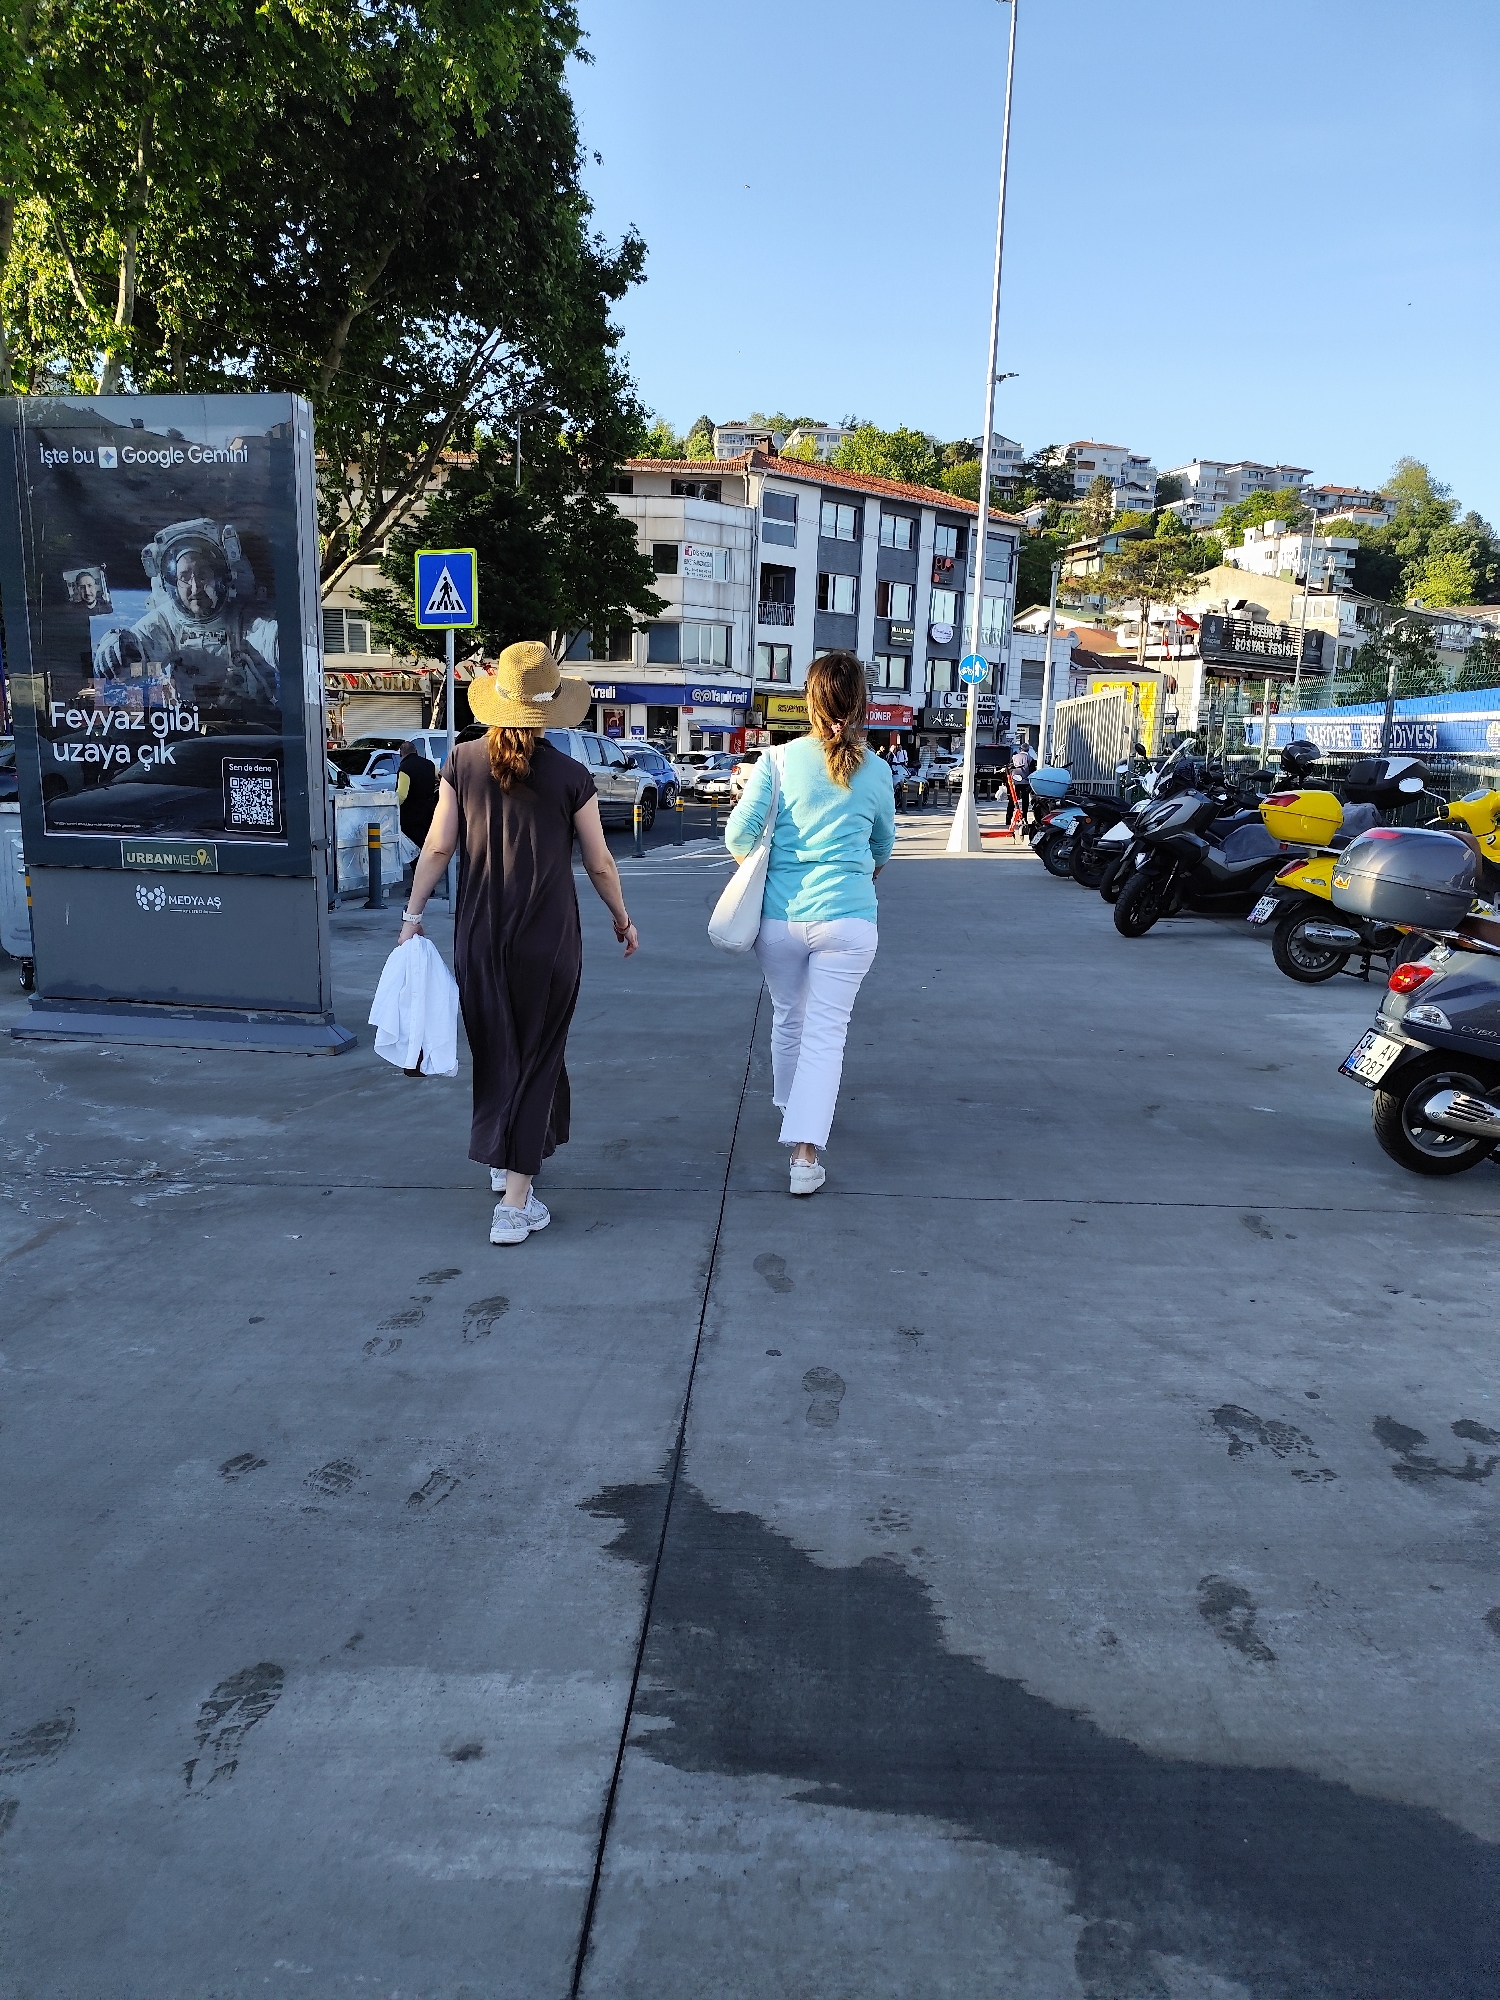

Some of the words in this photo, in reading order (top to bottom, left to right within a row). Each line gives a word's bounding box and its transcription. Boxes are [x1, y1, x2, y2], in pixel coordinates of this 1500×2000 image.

[39, 443, 69, 468] İşte
[72, 447, 95, 464] bu
[121, 445, 184, 468] Google
[187, 445, 248, 464] Gemini
[1235, 637, 1265, 654] SOSYAL
[50, 701, 146, 736] Feyyaz
[150, 705, 200, 738] gibi
[869, 708, 892, 721] DÖNER
[52, 742, 131, 770] uzaya
[137, 739, 177, 772] çık
[228, 763, 243, 771] Sen
[244, 763, 253, 772] de
[168, 895, 205, 906] MEDYA
[206, 896, 222, 910] AŞ
[1360, 1034, 1377, 1052] 34
[1377, 1044, 1400, 1062] AV
[1353, 1054, 1385, 1078] 0287
